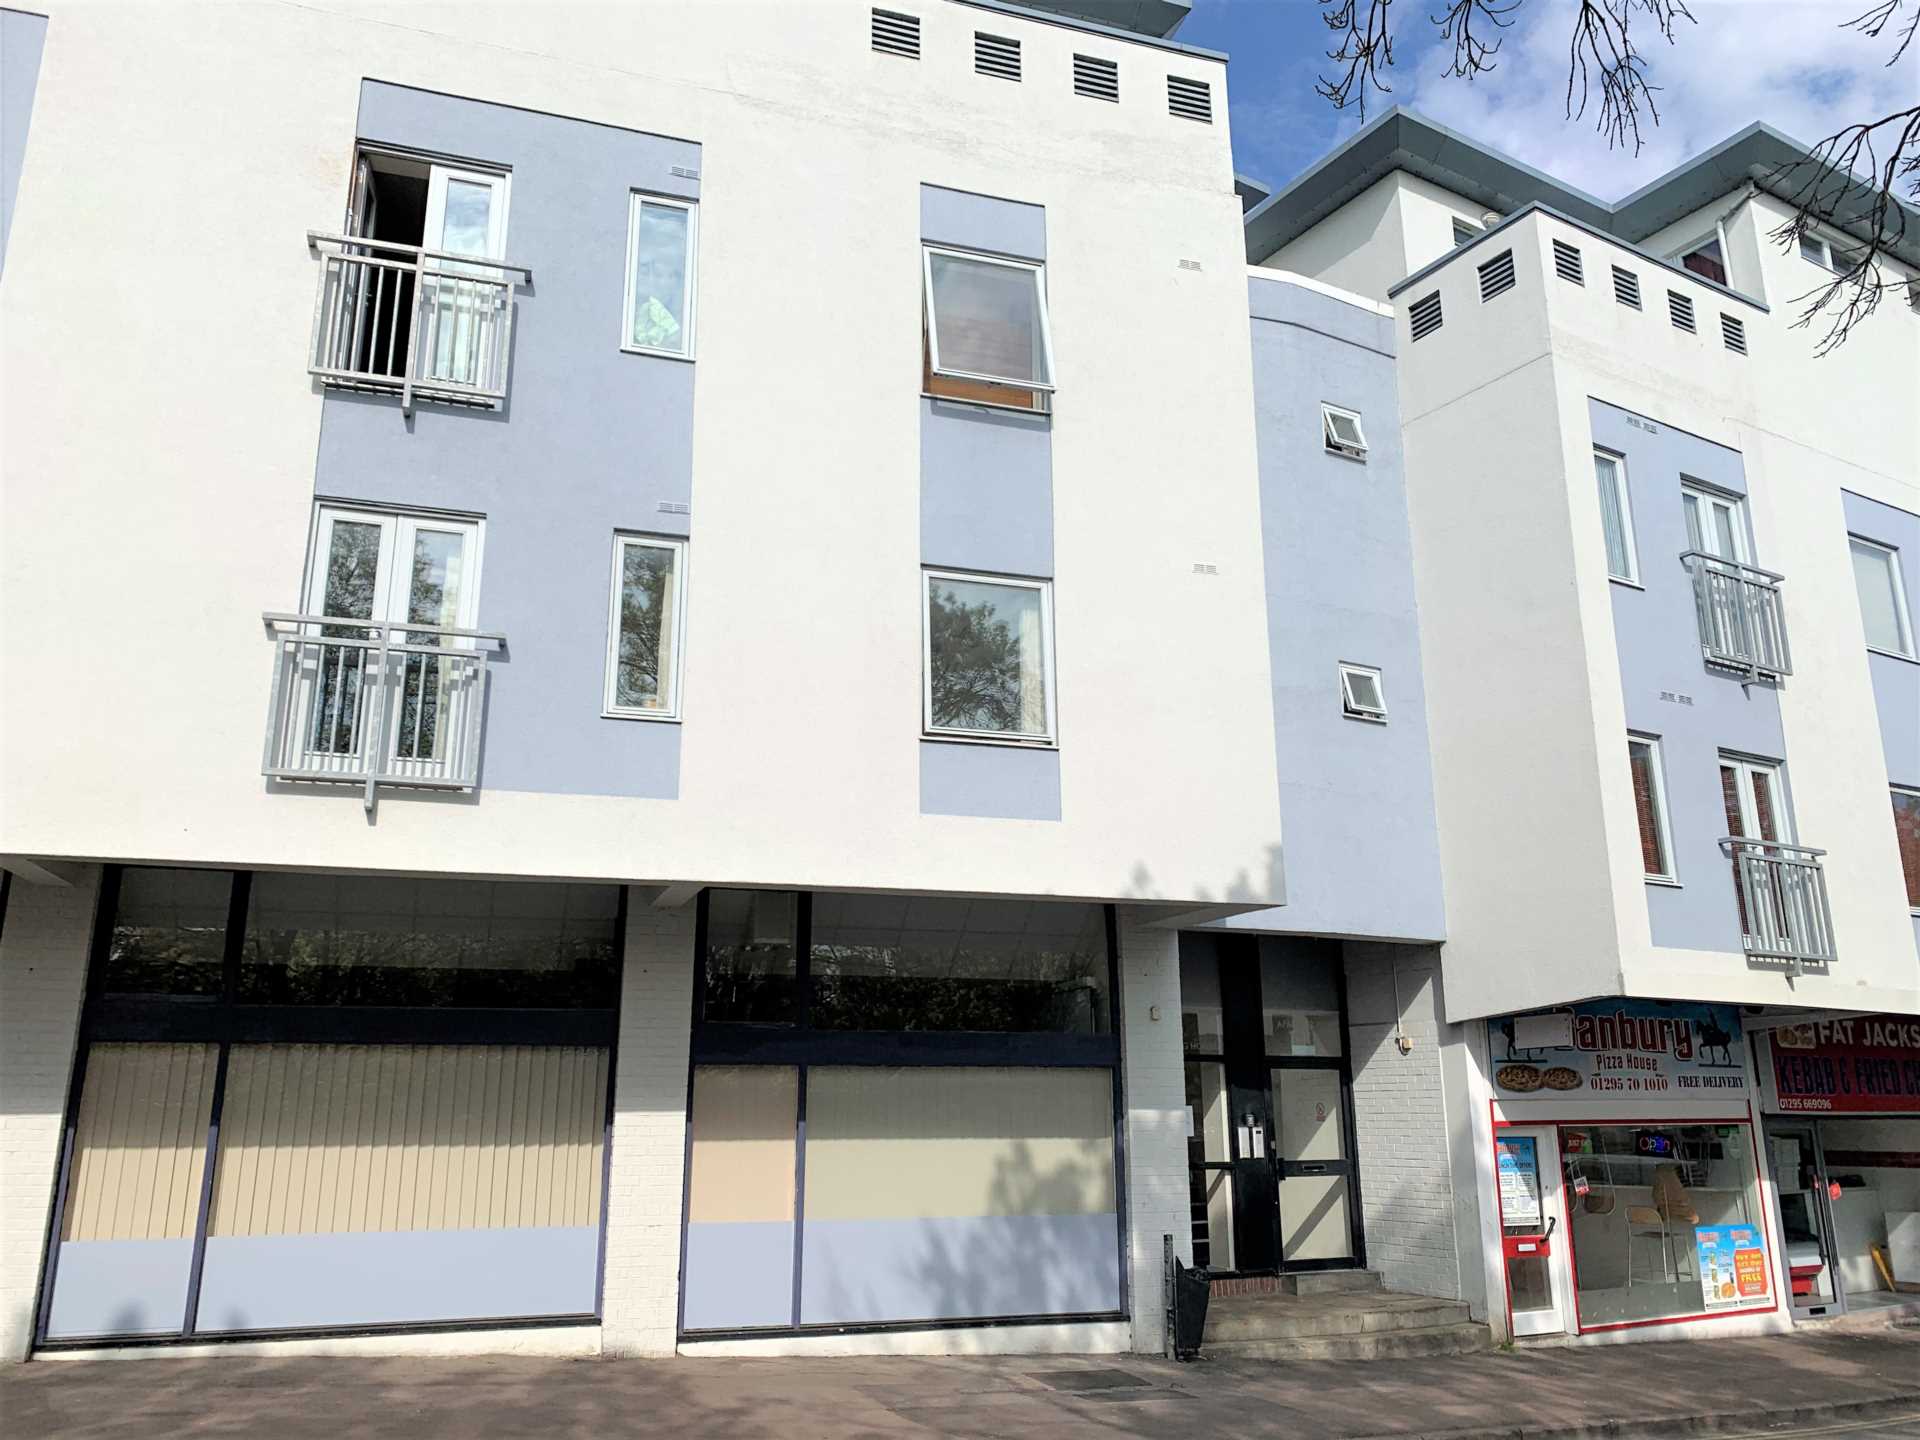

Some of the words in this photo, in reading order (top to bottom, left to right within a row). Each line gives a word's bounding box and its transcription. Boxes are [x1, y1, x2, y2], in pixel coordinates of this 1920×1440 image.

[1556, 1008, 1694, 1062] anbury
[1818, 1020, 1854, 1045] FAT
[1863, 1022, 1920, 1049] JACKS
[1596, 1053, 1623, 1070] Pizza
[1626, 1054, 1657, 1071] House
[1591, 1077, 1624, 1091] 01295
[1627, 1078, 1640, 1091] 70
[1644, 1078, 1669, 1092] 1010
[1678, 1076, 1700, 1088] FREE
[1702, 1076, 1744, 1088] DELIVERY
[1777, 1056, 1836, 1095] KEBAB
[1855, 1057, 1901, 1095] FRIED
[1780, 1098, 1802, 1109] 01295
